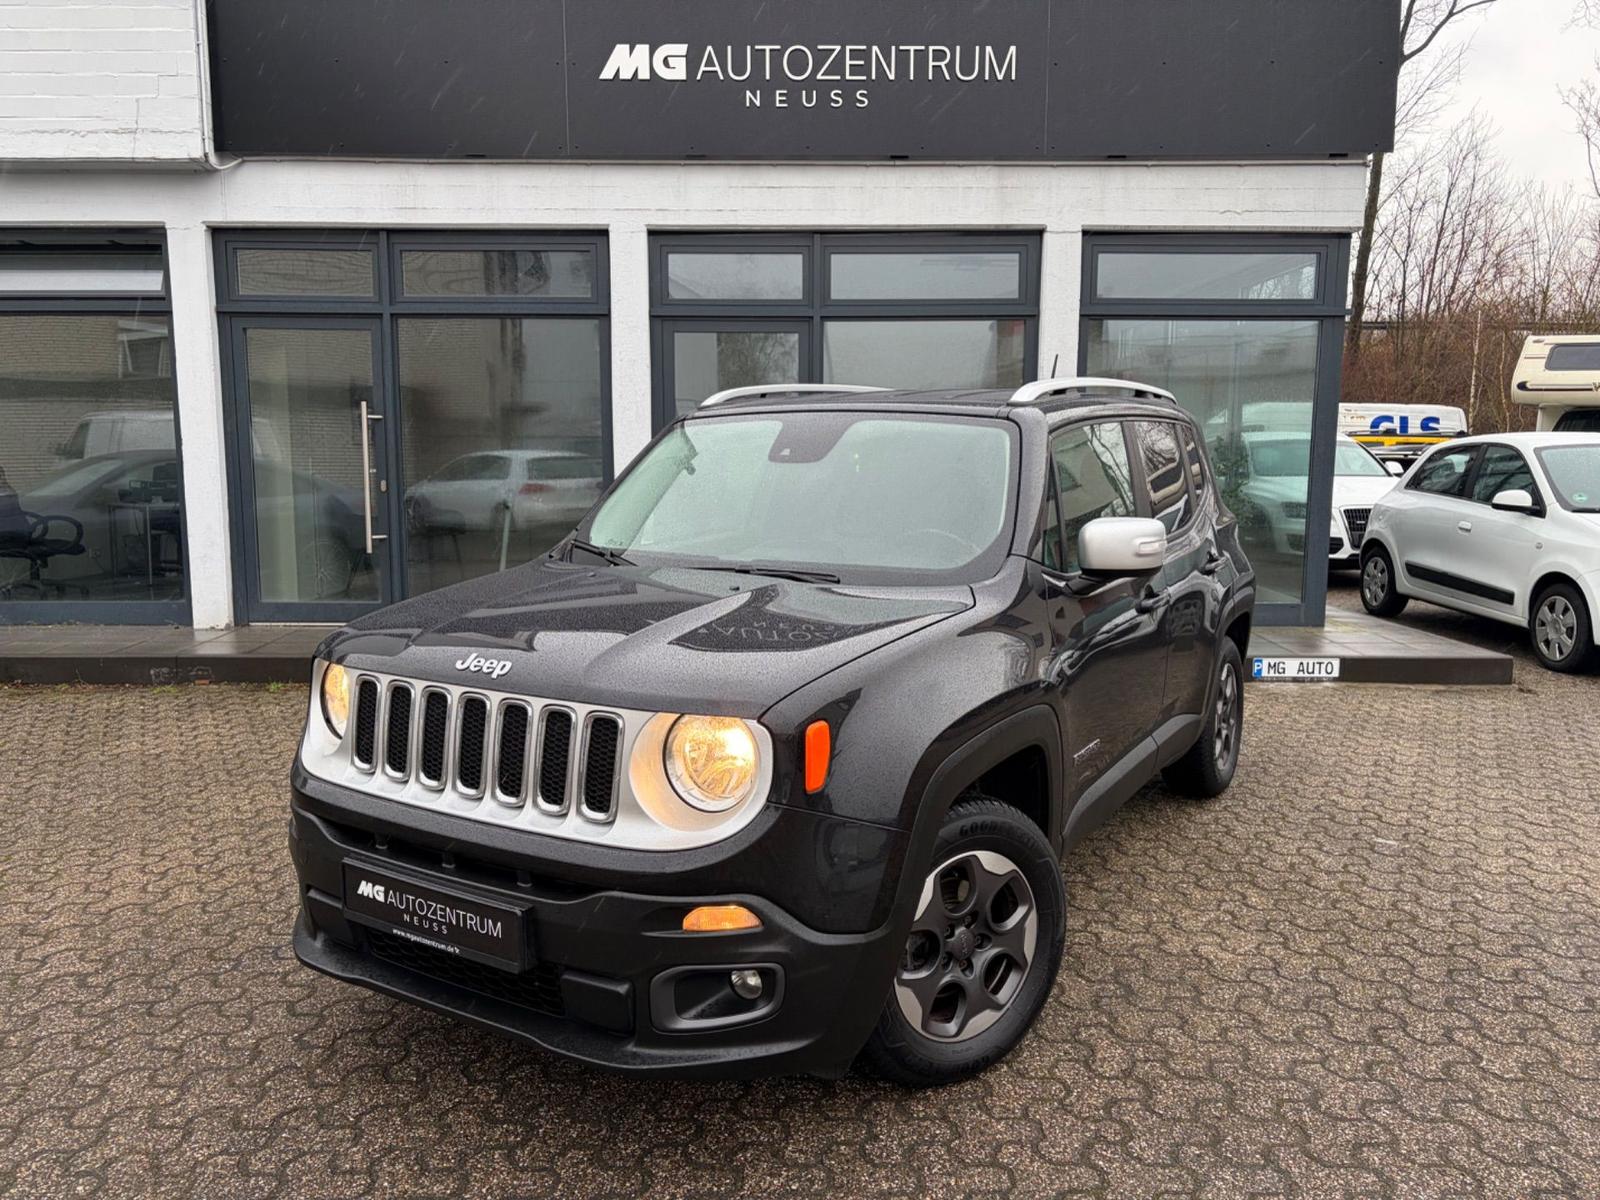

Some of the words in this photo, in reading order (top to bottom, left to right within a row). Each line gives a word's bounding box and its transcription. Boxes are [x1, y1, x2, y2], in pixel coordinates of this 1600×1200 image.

[599, 43, 689, 81] MG
[697, 44, 1017, 81] AUTOZENTRUM
[745, 89, 869, 107] NEUSS
[455, 652, 513, 679] Jeep
[1267, 661, 1286, 675] MG
[1297, 661, 1334, 675] AUTO
[357, 880, 385, 903] MG
[386, 890, 502, 938] AUTOZENTRUM
[403, 913, 448, 935] NEUSS
